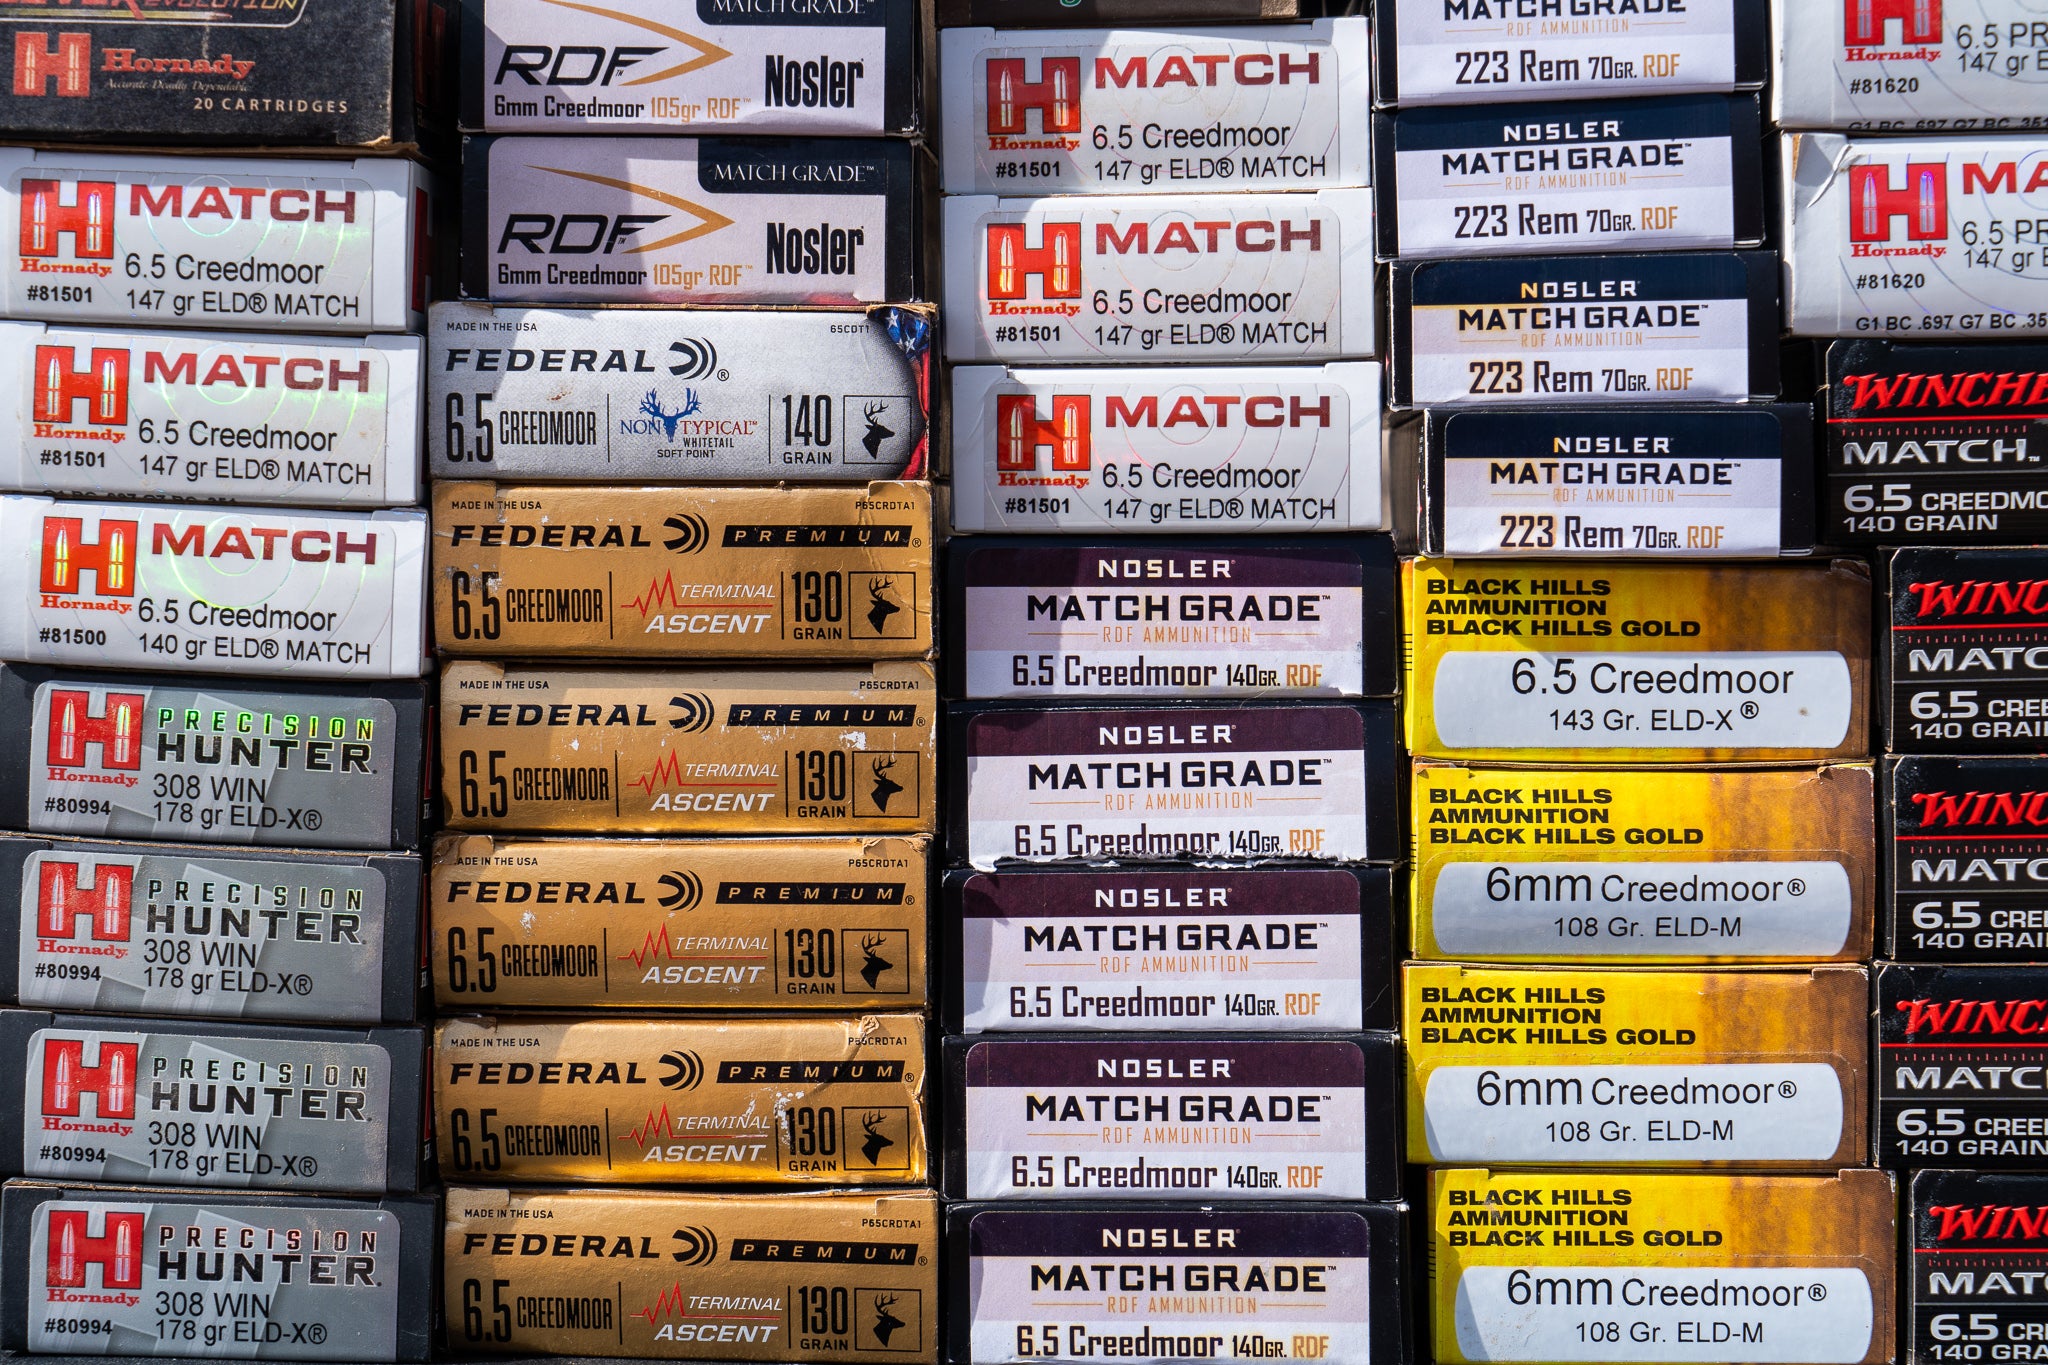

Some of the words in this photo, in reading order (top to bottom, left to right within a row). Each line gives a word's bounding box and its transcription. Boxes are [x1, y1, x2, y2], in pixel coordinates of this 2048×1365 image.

[1957, 24, 1998, 49] 6.5
[101, 48, 255, 78] Hornady
[1095, 53, 1319, 89] MATCH
[1456, 51, 1509, 84] 223
[1520, 50, 1579, 82] Rem
[1643, 54, 1680, 78] RDF
[1850, 78, 1919, 93] #81620
[195, 98, 213, 110] 20
[222, 98, 348, 113] CARTRIDGES
[495, 96, 538, 118] 6mm
[544, 96, 644, 118] Creedmoor
[651, 97, 701, 123] 105gr
[1092, 125, 1133, 149] 6.5
[1143, 123, 1290, 149] Creedmoor
[714, 165, 787, 181] MATCH
[996, 162, 1061, 178] #81501
[1095, 161, 1132, 181] 147
[1142, 165, 1163, 184] gr
[1170, 160, 1234, 180] ELD®
[1241, 155, 1326, 178] MATCH
[1506, 177, 1529, 190] RDF
[1538, 173, 1626, 190] AMMUNITION
[130, 184, 355, 223] MATCH
[1454, 205, 1508, 238] 223
[1519, 203, 1577, 236] Rem
[1641, 207, 1678, 230] RDF
[1962, 221, 2003, 245] 6.5
[125, 254, 165, 278] 6.5
[176, 255, 324, 284] Creedmoor
[499, 264, 541, 285] 6mm
[548, 264, 647, 286] Creedmoor
[653, 265, 703, 290] 105gr
[1856, 274, 1925, 289] #81620
[28, 286, 93, 303] #81501
[127, 290, 164, 310] 147
[173, 294, 195, 314] gr
[202, 292, 267, 314] ELD®
[275, 294, 358, 316] MATCH
[447, 322, 477, 331] MADE
[480, 322, 488, 331] IN
[491, 322, 512, 331] THE
[515, 322, 537, 331] USA
[1856, 317, 1879, 330] G1
[1886, 316, 1912, 330] BC
[1917, 316, 1953, 330] .697
[1960, 314, 1983, 329] G7
[1990, 313, 2016, 328] BC
[446, 349, 655, 372] FEDERAL
[447, 394, 494, 462] 6.5
[500, 411, 596, 445] CREEDMOOR
[620, 419, 661, 435] NON
[783, 394, 831, 447] 140
[683, 437, 734, 447] WHITETAIL
[41, 450, 105, 467] #81501
[657, 449, 683, 458] SOFT
[687, 449, 715, 458] POINT
[783, 452, 832, 464] GRAIN
[451, 501, 481, 510] MADE
[484, 501, 494, 510] IN
[498, 501, 517, 510] THE
[520, 501, 542, 510] USA
[855, 500, 915, 510] P65CRDTA1
[1006, 498, 1070, 514] #81501
[1844, 484, 1912, 512] 6.5
[1843, 516, 1895, 533] 140
[1905, 514, 1997, 532] GRAIN
[152, 523, 376, 564] MATCH
[451, 525, 651, 547] FEDERAL
[735, 530, 903, 543] PREMIUM
[680, 584, 775, 598] TERMINAL
[791, 571, 842, 622] 130
[1427, 580, 1525, 595] BLACK
[1530, 580, 1611, 595] HILLS
[138, 599, 178, 624] 6.5
[189, 601, 336, 631] Creedmoor
[452, 571, 500, 640] 6.5
[506, 588, 602, 622] CREEDMOOR
[1426, 600, 1606, 615] AMMUNITION
[645, 615, 770, 634] ASCENT
[793, 628, 842, 640] GRAIN
[1103, 626, 1133, 643] RDF
[1144, 626, 1251, 643] AMMUNITION
[1427, 620, 1526, 636] BLACK
[1531, 620, 1612, 636] HILLS
[1621, 621, 1701, 637] GOLD
[40, 628, 106, 646] #81500
[140, 635, 177, 654] 140
[186, 639, 206, 659] gr
[215, 636, 279, 659] ELD®
[287, 640, 371, 664] MATCH
[1013, 656, 1053, 686] 6.5
[1064, 656, 1216, 686] Creedmoor
[1287, 664, 1322, 686] RDF
[1512, 659, 1576, 695] 6.5
[1590, 663, 1793, 695] Creedmoor
[1910, 691, 1979, 719] 6.5
[158, 707, 373, 741] PRECISION
[1549, 710, 1593, 731] 143
[1603, 709, 1640, 732] Gr.
[153, 775, 200, 798] 308
[210, 776, 266, 802] WIN
[460, 750, 507, 818] 6.5
[513, 768, 609, 801] CREEDMOOR
[45, 798, 111, 815] #80994
[1430, 789, 1523, 804] BLACK
[1532, 789, 1613, 804] HILLS
[153, 802, 193, 823] 178
[201, 806, 223, 829] gr
[230, 806, 322, 830] ELD-X®
[1487, 868, 1592, 902] 6mm
[1554, 917, 1598, 938] 108
[1607, 918, 1644, 938] Gr.
[1656, 917, 1742, 938] ELD-M
[36, 964, 101, 980] #80994
[1010, 987, 1051, 1018] 6.5
[1062, 986, 1215, 1017] Creedmoor
[1285, 993, 1321, 1015] RDF
[1448, 1211, 1628, 1226] AMMUNITION
[1507, 1270, 1612, 1306] 6mm
[155, 1292, 204, 1316] 308
[214, 1294, 270, 1318] WIN
[688, 1296, 783, 1311] TERMINAL
[798, 1286, 848, 1335] 130
[45, 1318, 112, 1334] #80994
[156, 1320, 195, 1340] 178
[205, 1322, 226, 1345] gr
[234, 1321, 327, 1345] ELD-X®
[654, 1325, 778, 1343] ASCENT
[1576, 1322, 1620, 1344] 108
[1630, 1323, 1667, 1344] Gr.
[1677, 1322, 1764, 1344] ELD-M
[800, 1340, 849, 1351] GRAIN
